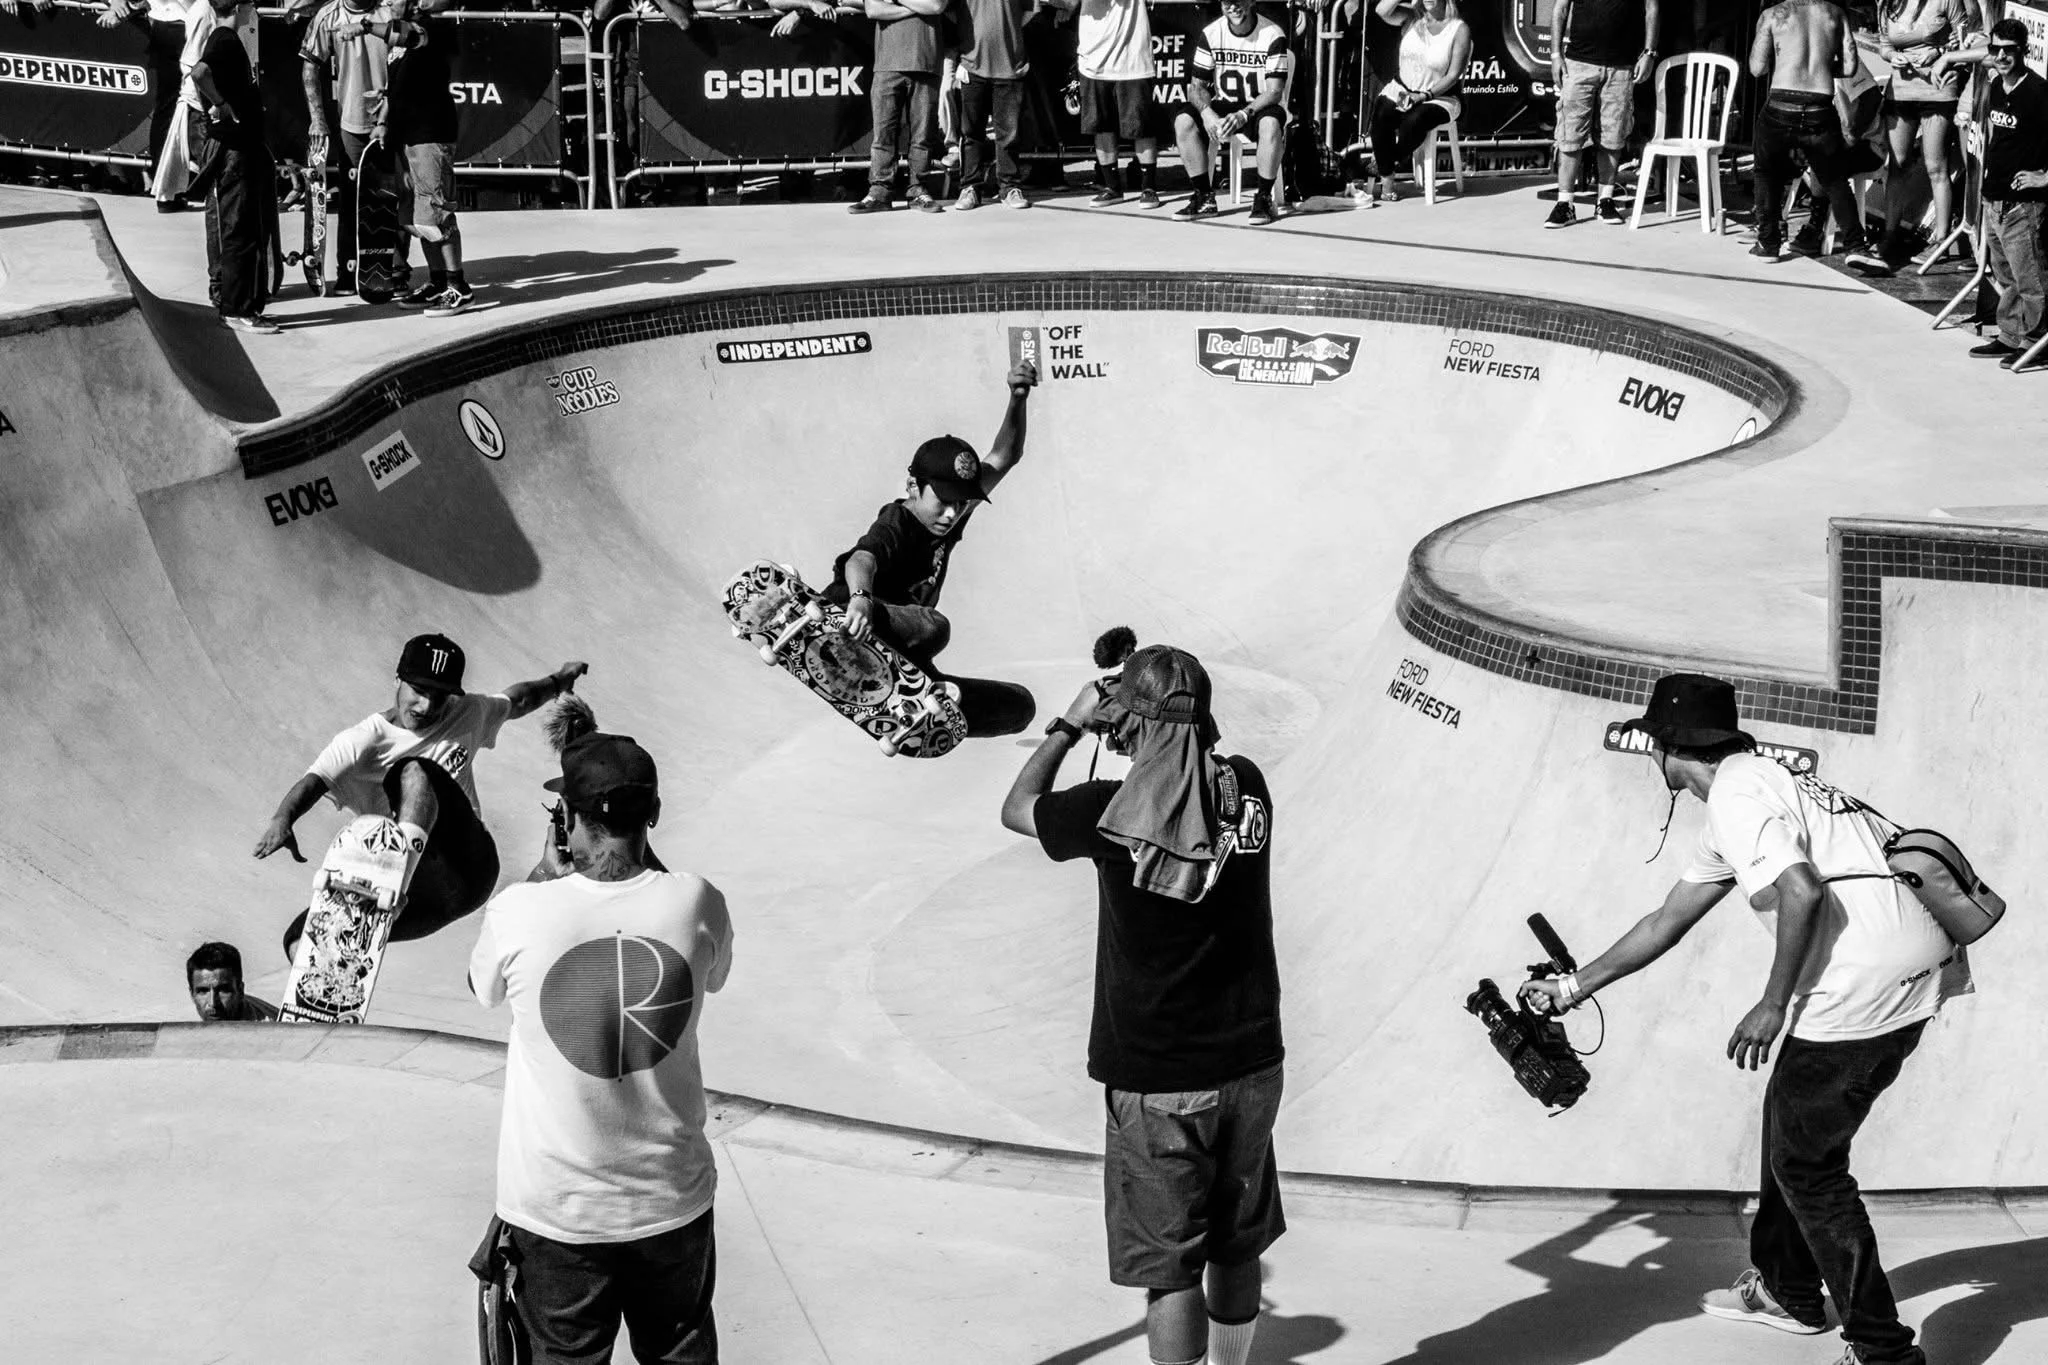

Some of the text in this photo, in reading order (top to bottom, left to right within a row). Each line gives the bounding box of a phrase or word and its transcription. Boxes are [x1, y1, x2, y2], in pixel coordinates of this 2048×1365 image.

[1154, 59, 1185, 79] HE
[704, 66, 864, 99] G-SHOCK
[1219, 69, 1260, 103] 91
[1497, 84, 1519, 94] Estilo
[728, 335, 857, 361] INDEPENDENT
[1049, 345, 1083, 360] THE
[1206, 333, 1287, 358] Red Bull
[1449, 339, 1494, 358] FORD
[561, 366, 597, 392] CUP
[1443, 356, 1540, 381] NEW FIESTA
[555, 381, 620, 416] NOODLES
[369, 440, 412, 480] G-SHOCK
[1397, 659, 1429, 685] FORD
[1386, 679, 1461, 729] NEW FIESTA
